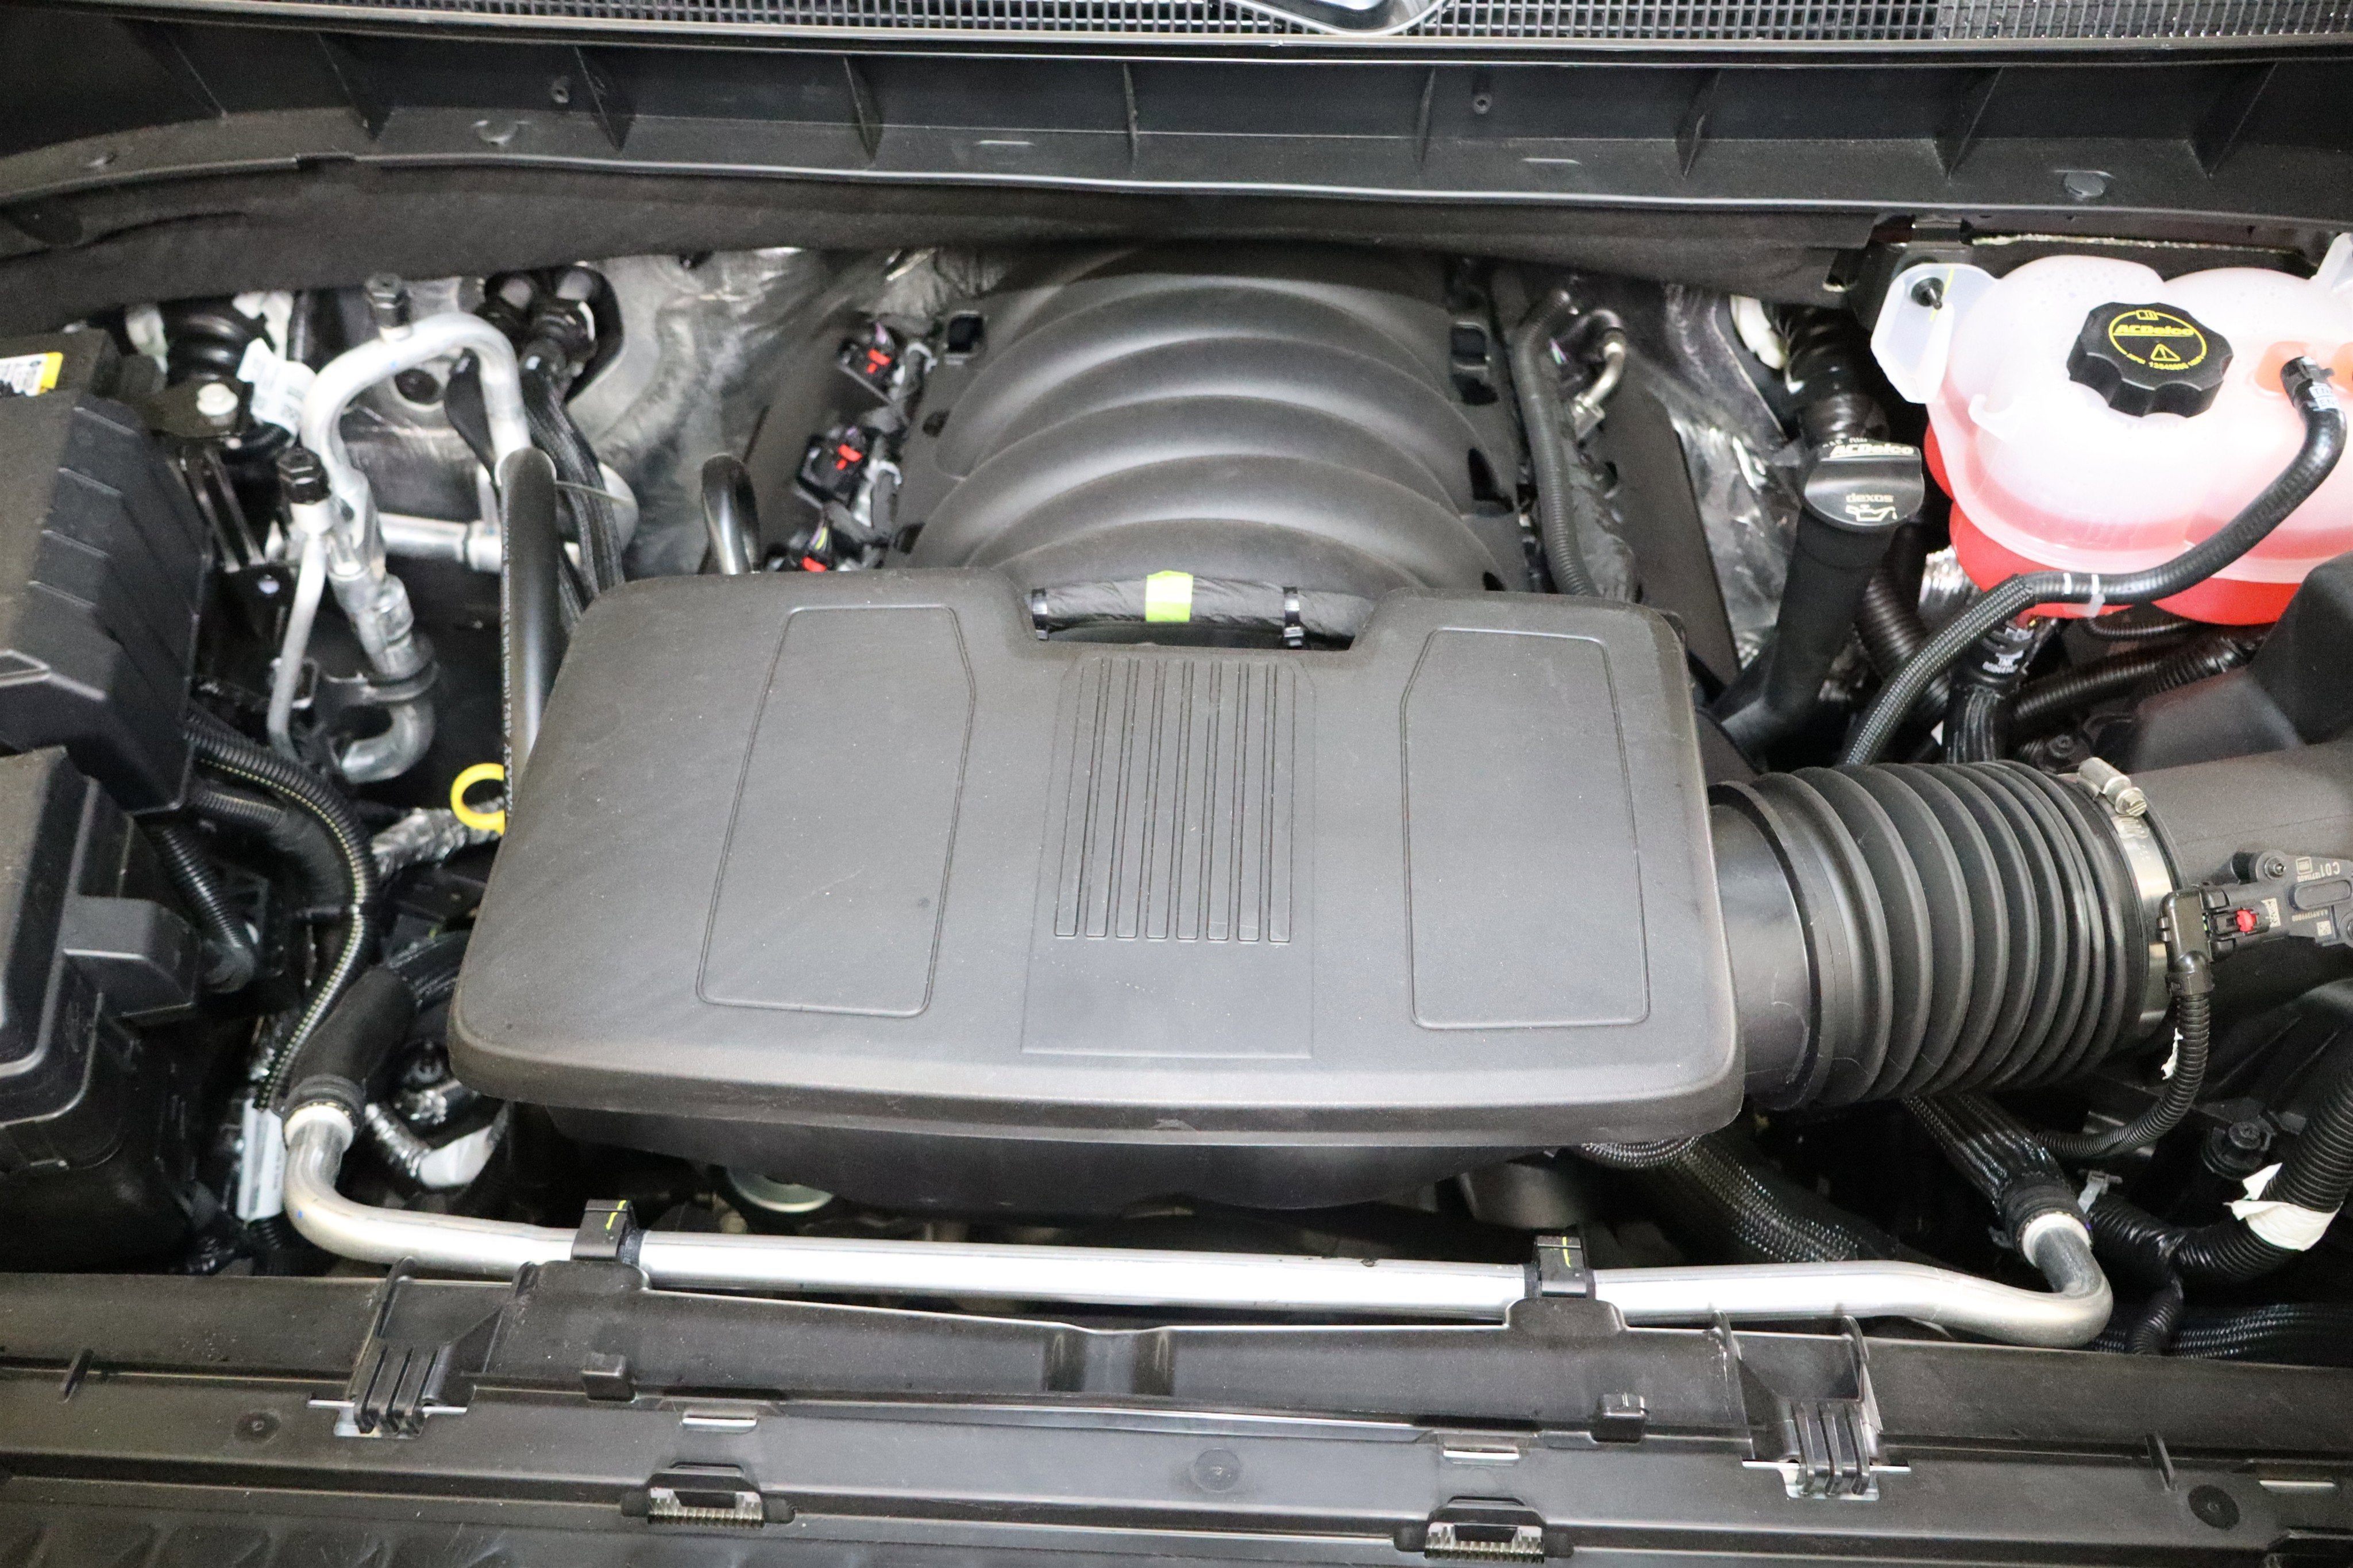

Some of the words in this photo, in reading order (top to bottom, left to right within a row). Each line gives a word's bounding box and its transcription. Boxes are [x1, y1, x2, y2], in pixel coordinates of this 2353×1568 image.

[2114, 324, 2194, 336] ACDelco
[1829, 443, 1915, 457] ACDelco
[1846, 493, 1893, 503] dexos
